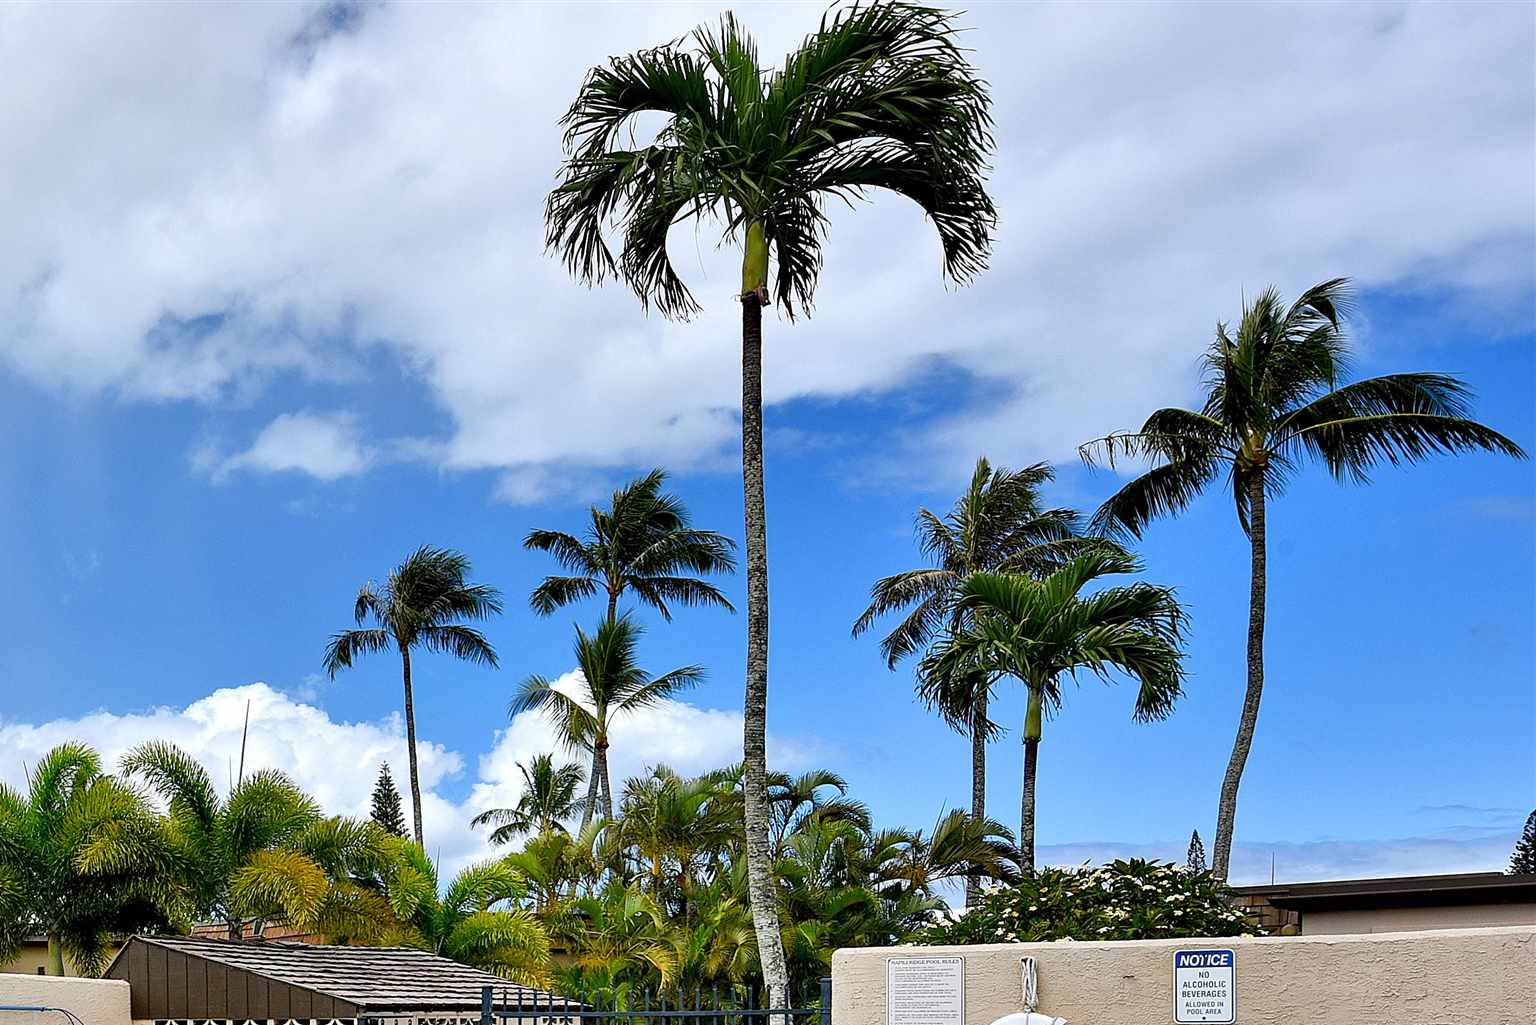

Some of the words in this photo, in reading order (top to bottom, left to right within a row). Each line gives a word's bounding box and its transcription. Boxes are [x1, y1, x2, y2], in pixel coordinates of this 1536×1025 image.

[1179, 954, 1230, 966] NOTICE
[1198, 971, 1210, 979] NO
[1182, 990, 1227, 998] BEVERAGES
